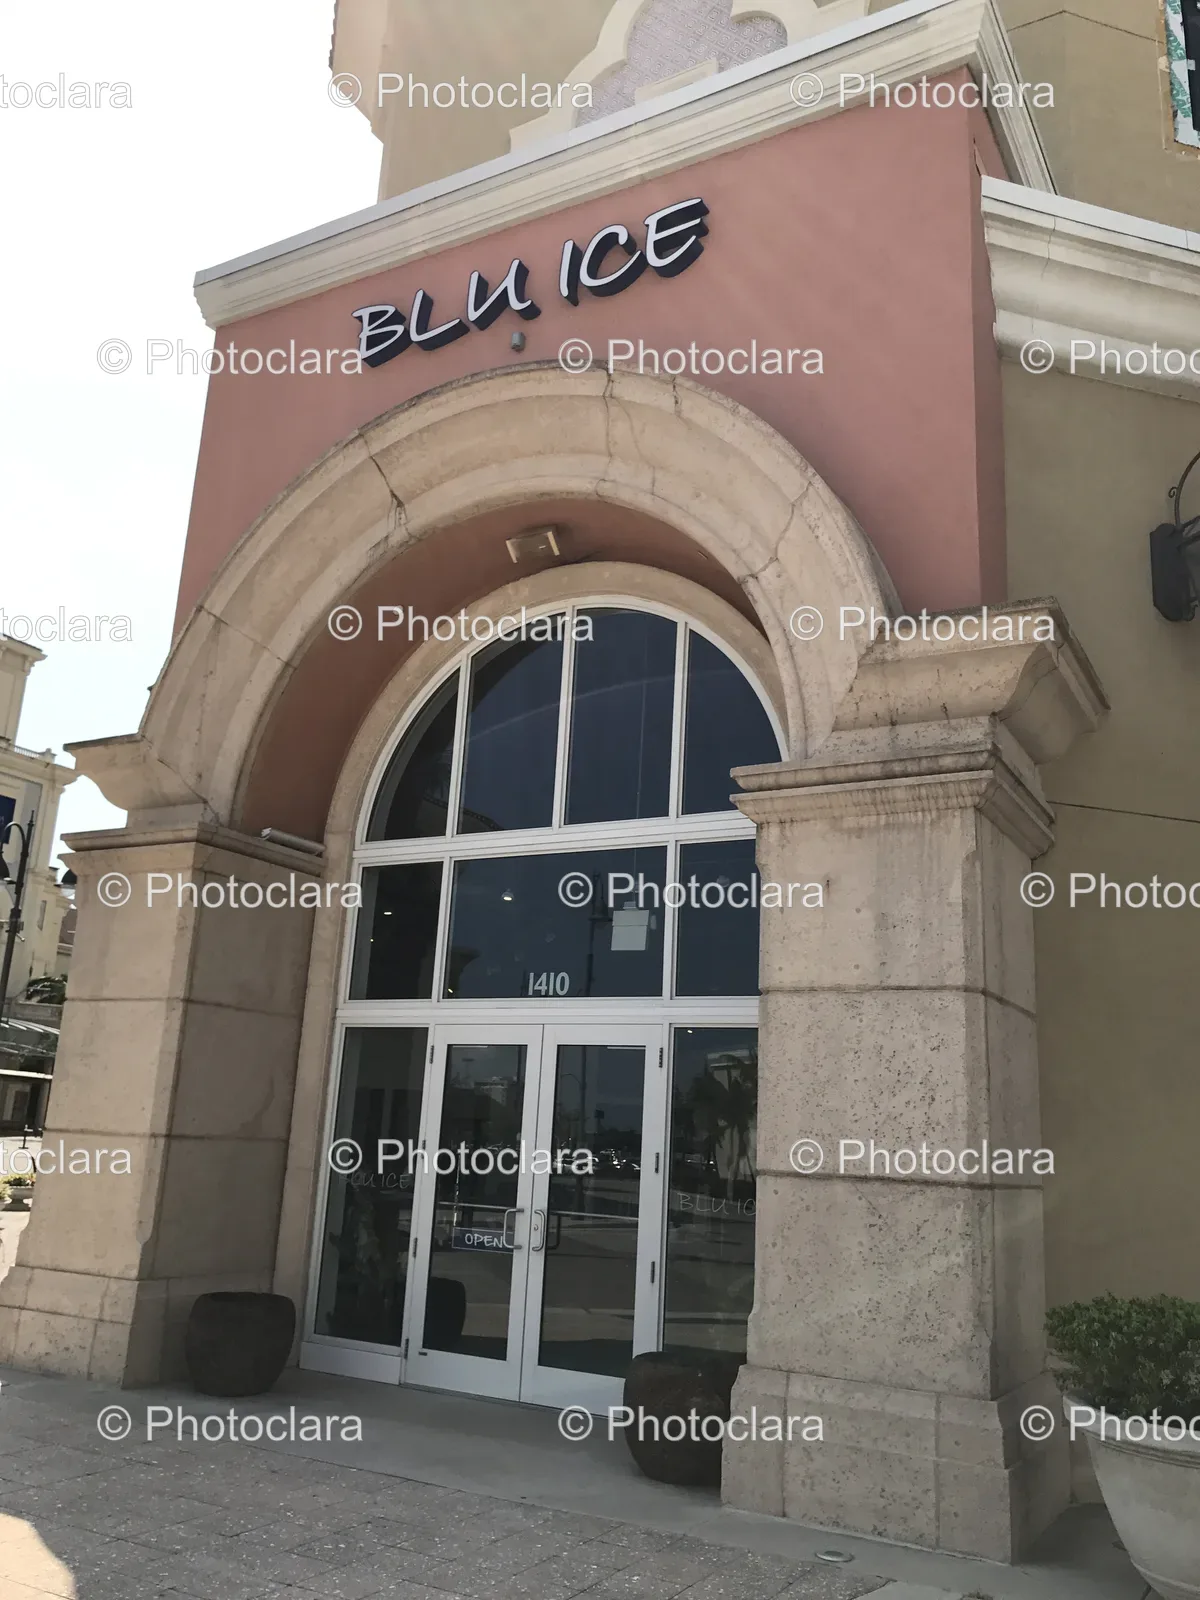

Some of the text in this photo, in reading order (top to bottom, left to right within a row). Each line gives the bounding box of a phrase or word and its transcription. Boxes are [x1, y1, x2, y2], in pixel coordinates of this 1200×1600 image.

[351, 197, 709, 368] BLU ICE
[528, 971, 570, 996] 1410
[677, 1192, 729, 1215] BLU
[464, 1233, 503, 1249] OPEN
